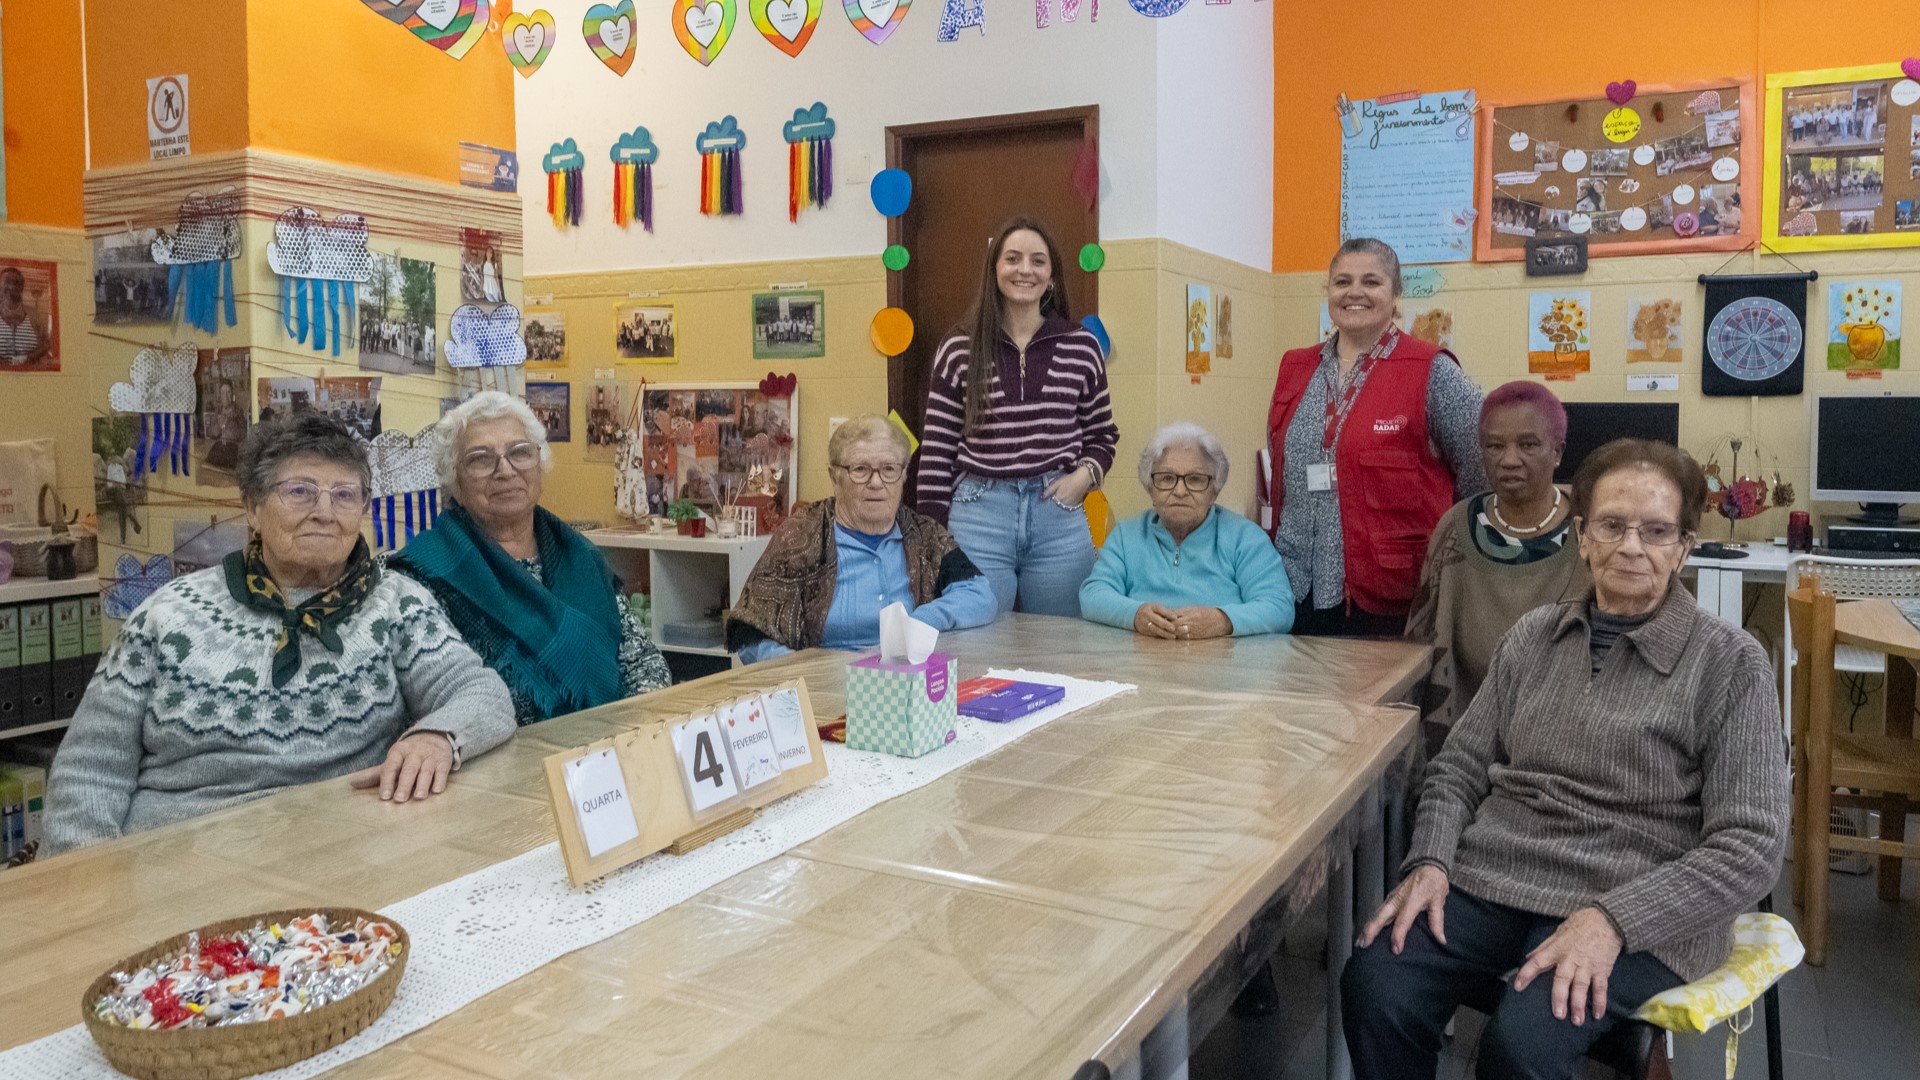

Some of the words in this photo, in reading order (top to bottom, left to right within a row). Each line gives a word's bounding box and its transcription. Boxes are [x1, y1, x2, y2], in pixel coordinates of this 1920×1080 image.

[1411, 100, 1436, 116] de
[150, 137, 176, 147] MANTENHA
[178, 135, 189, 144] ESTE
[154, 150, 168, 159] LOCAL
[169, 147, 186, 157] LIMPO
[732, 730, 769, 751] FEVEREIRO
[693, 730, 724, 788] 4
[777, 745, 806, 761] INVERNO
[582, 789, 623, 814] QUARTA
